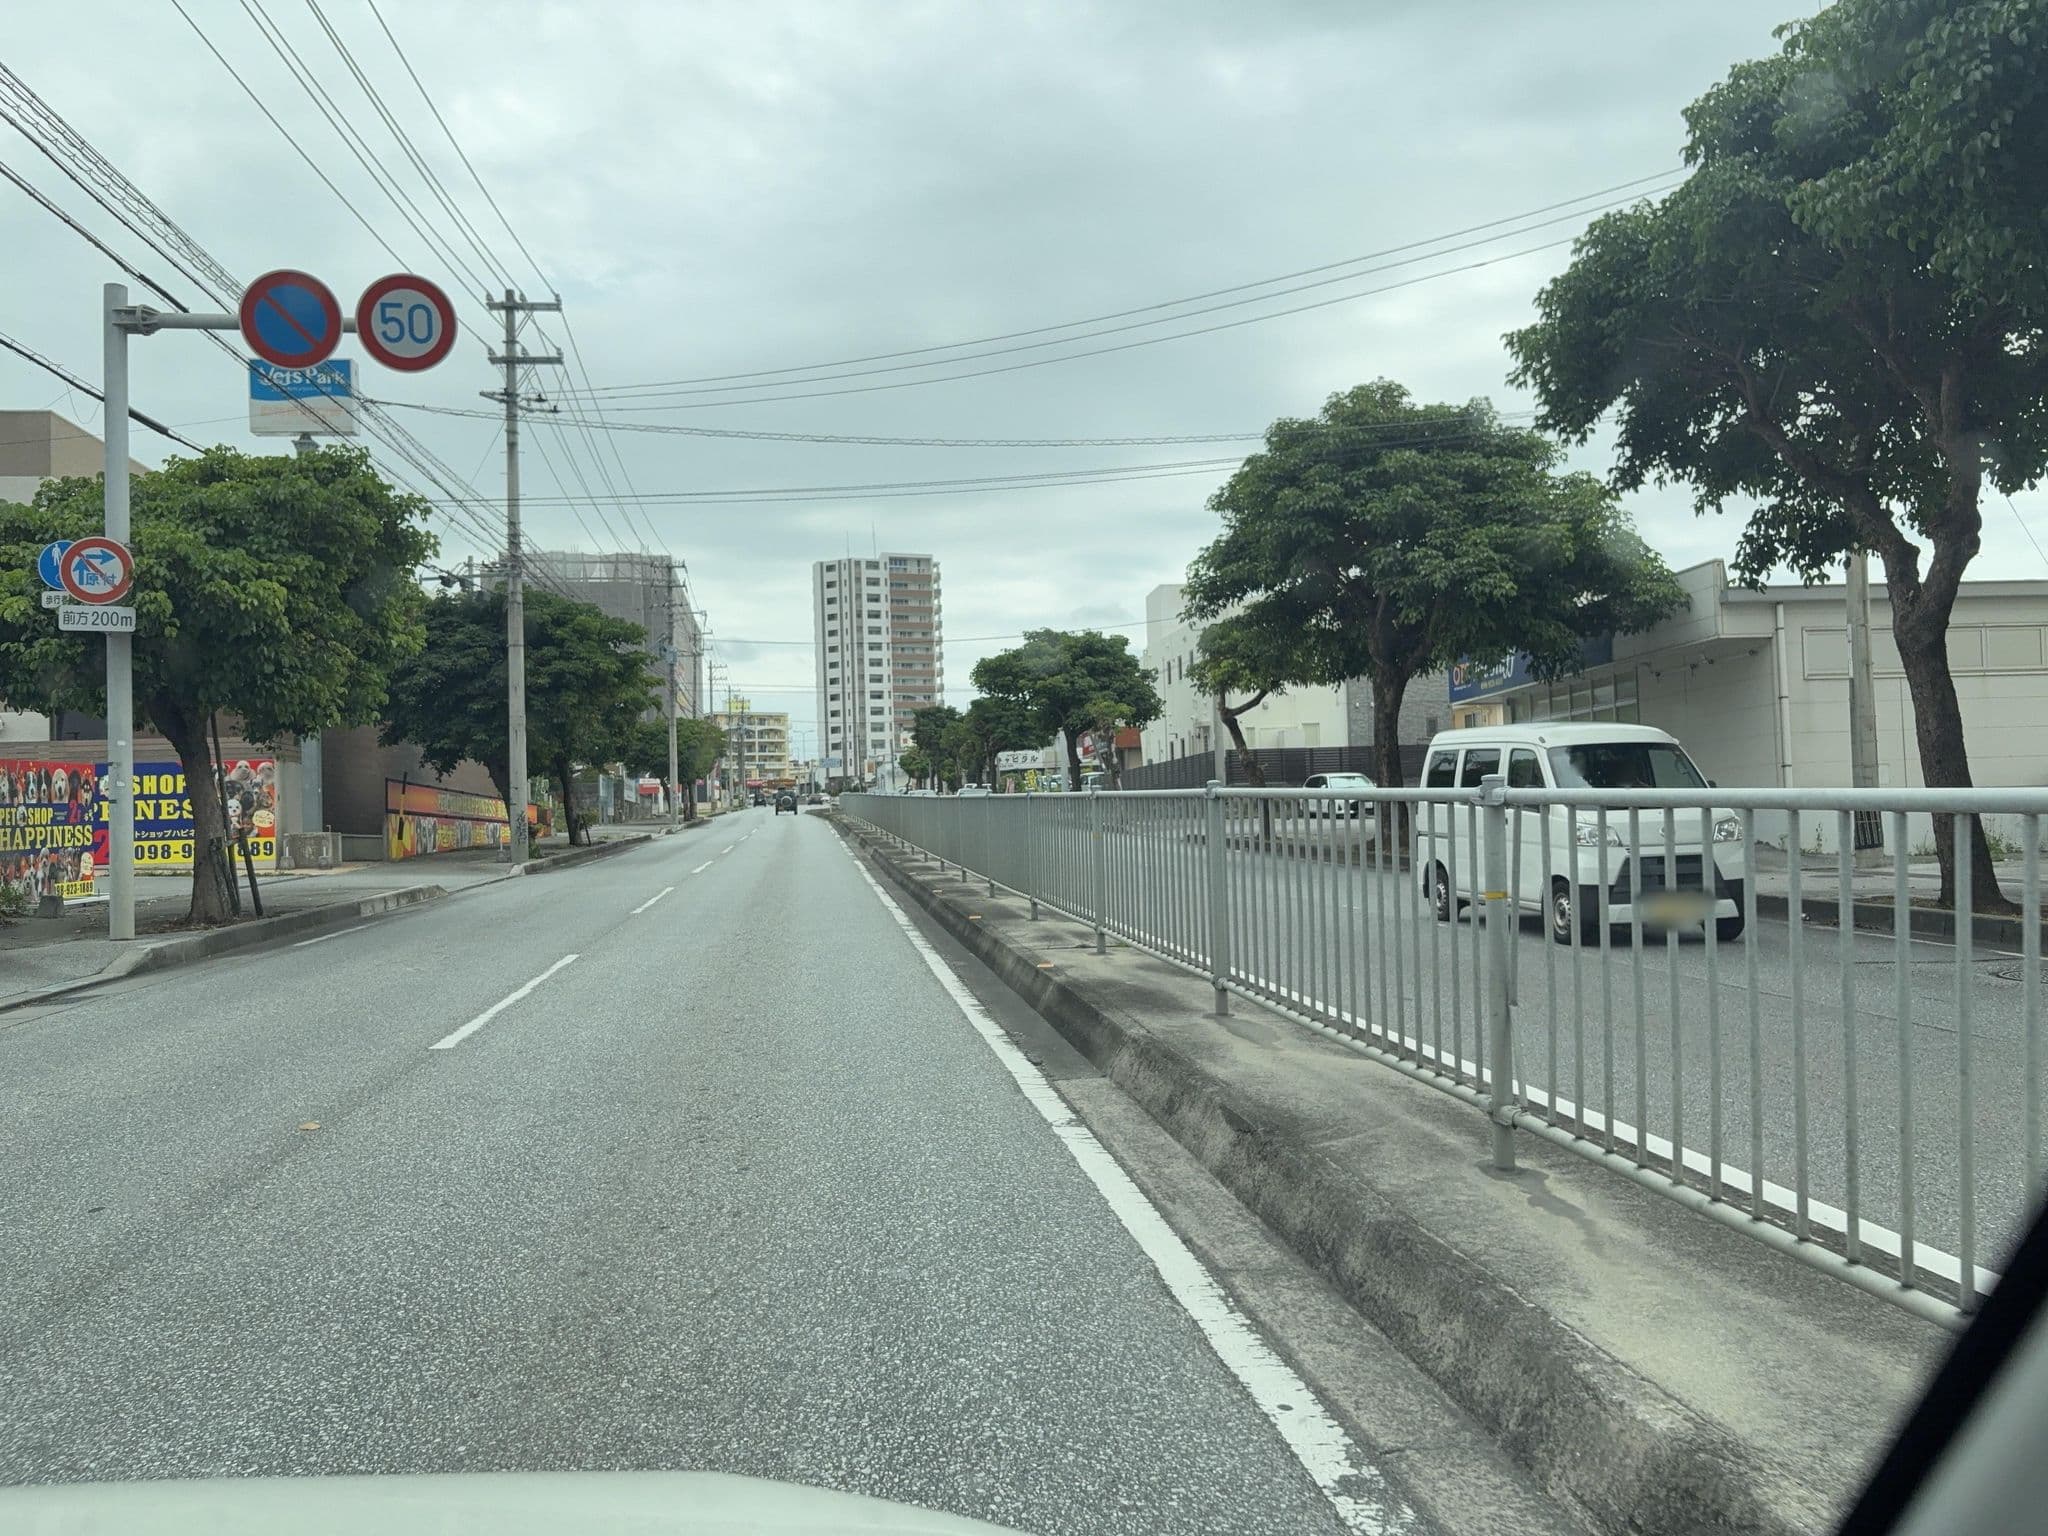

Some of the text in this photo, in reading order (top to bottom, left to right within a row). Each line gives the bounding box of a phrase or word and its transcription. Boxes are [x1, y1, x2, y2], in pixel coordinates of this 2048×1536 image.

[380, 302, 433, 344] 50
[86, 572, 117, 586] 原付
[28, 807, 53, 825] SHOP
[0, 825, 93, 851] HAPPINESS
